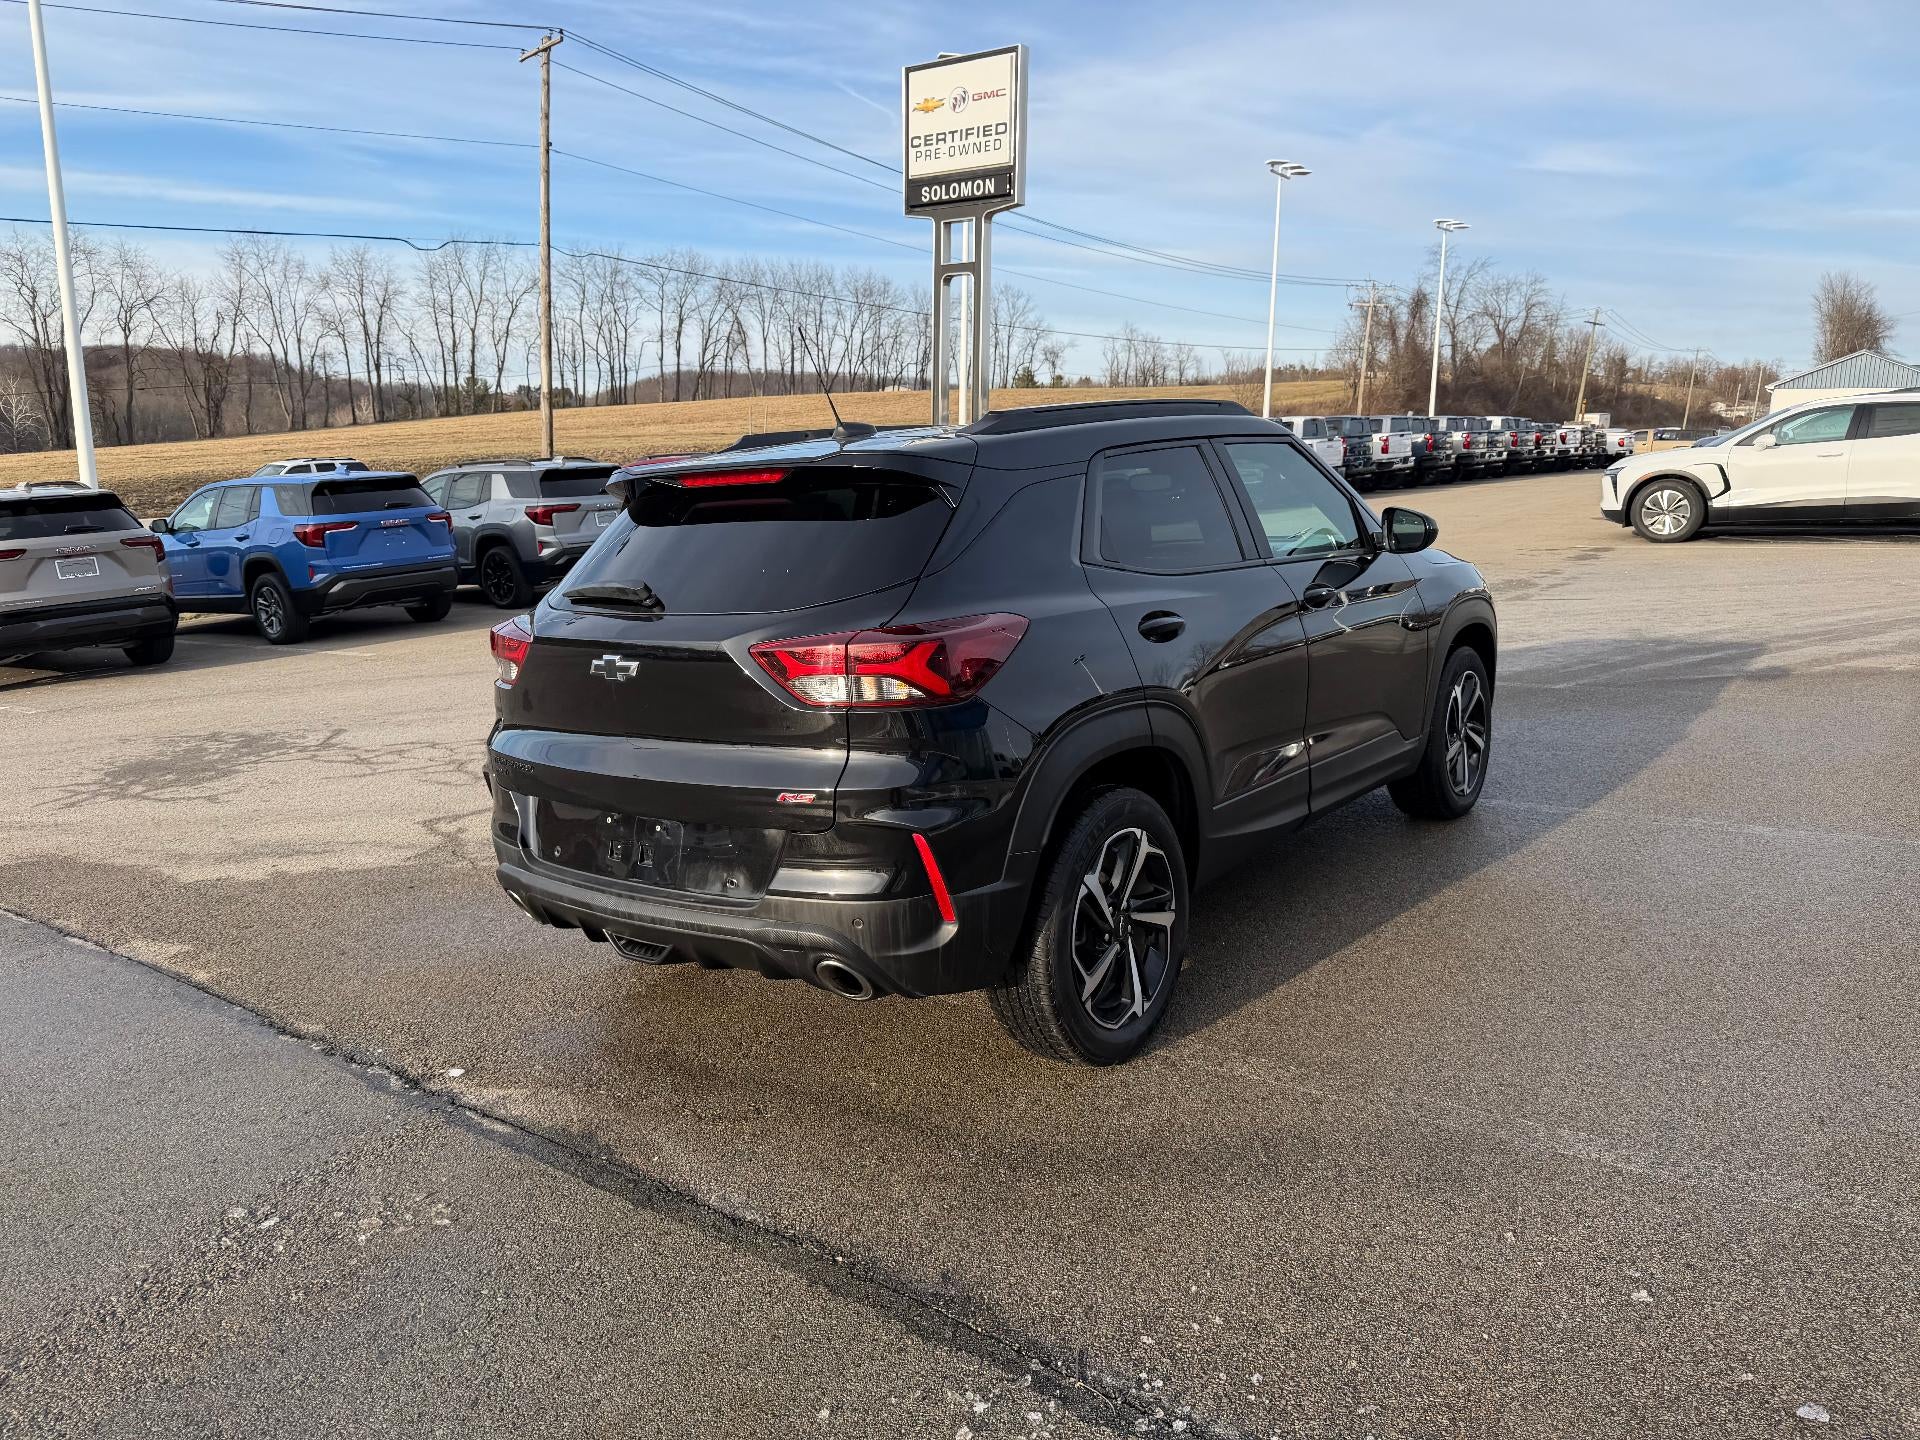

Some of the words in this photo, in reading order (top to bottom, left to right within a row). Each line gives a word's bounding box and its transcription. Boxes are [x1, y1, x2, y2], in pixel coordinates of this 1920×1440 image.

[972, 88, 1007, 101] GMC
[910, 122, 1008, 149] CERTIFIED
[915, 138, 1002, 162] PRE-OWNED
[921, 177, 995, 202] SOLOMON
[776, 793, 816, 804] RS
